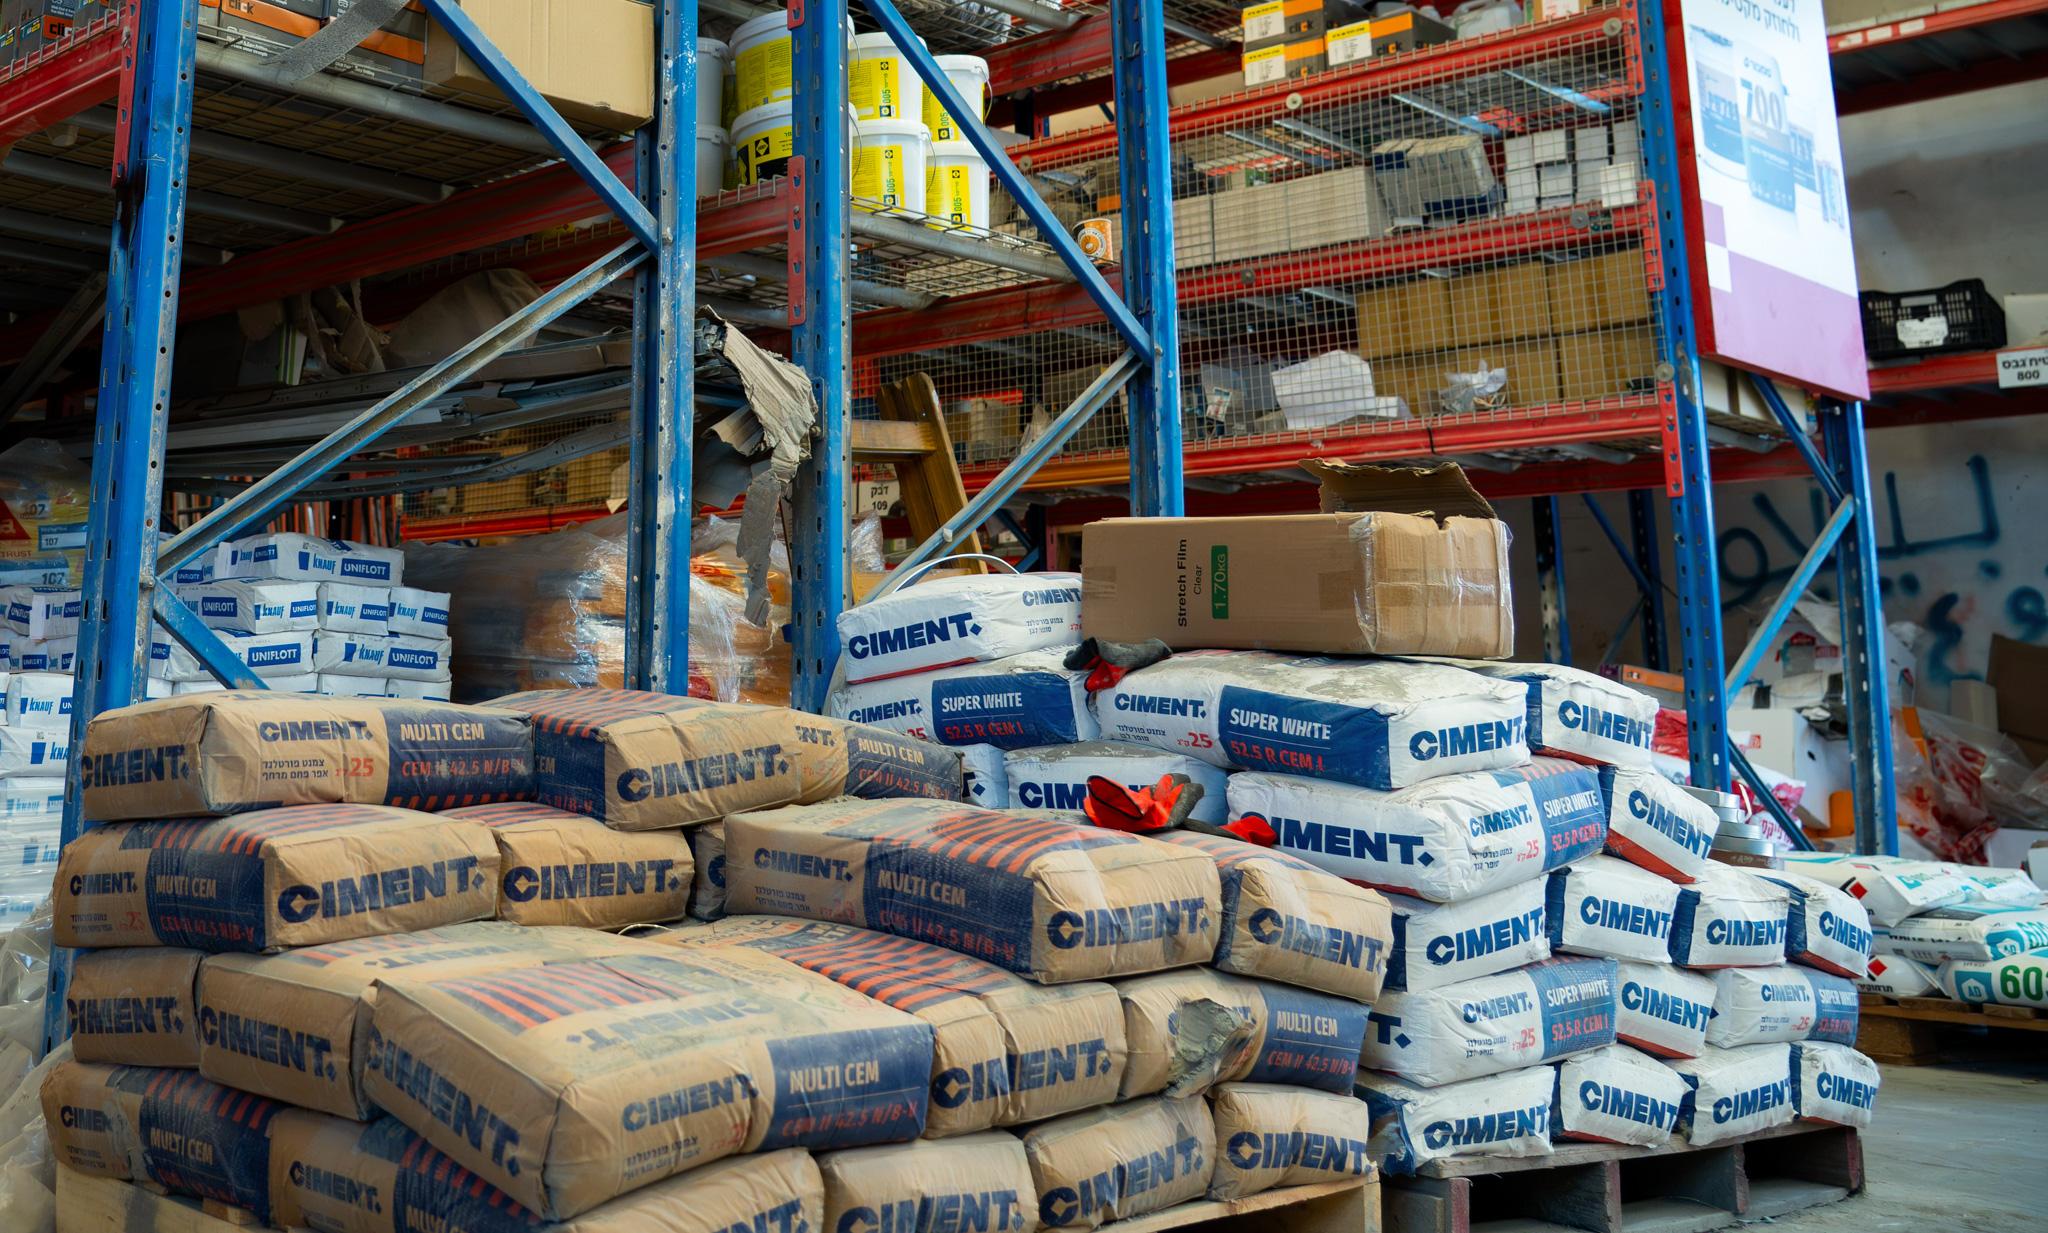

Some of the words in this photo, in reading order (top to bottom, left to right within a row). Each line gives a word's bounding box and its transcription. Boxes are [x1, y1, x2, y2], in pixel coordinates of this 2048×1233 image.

[2017, 370, 2040, 381] 800
[872, 501, 888, 510] 109
[1178, 538, 1188, 569] Film
[344, 563, 386, 576] UNIFLOTT
[1194, 564, 1202, 596] Clear
[292, 603, 316, 614] UNIFLOT
[1178, 572, 1188, 627] Stretch
[424, 611, 448, 622] UNIFLOT
[252, 649, 298, 662] UNIFLOTT
[392, 652, 434, 664] UNIFLOTT
[942, 694, 981, 713] SUPER
[984, 692, 1022, 710] WHITE
[400, 723, 448, 742] MULTI
[451, 723, 486, 741] CEM
[944, 725, 974, 740] 52.5
[975, 724, 984, 737] R
[988, 722, 1015, 736] CEM
[1229, 708, 1278, 732] SUPER
[1282, 717, 1332, 740] WHITE
[1188, 732, 1213, 749] 25
[858, 737, 897, 758] MULTI
[899, 746, 924, 766] CEM
[1230, 740, 1263, 760] 52.5
[1265, 746, 1276, 764] R
[1280, 749, 1312, 769] CEM
[303, 758, 324, 768] צמנט
[350, 758, 374, 776] 25
[401, 760, 430, 778] CEM
[450, 759, 480, 776] 42.5
[1544, 798, 1572, 820] SUPER
[1240, 812, 1424, 865] IMENT
[1526, 839, 1540, 860] 25
[192, 878, 216, 899] CEM
[878, 870, 928, 900] MULTI
[931, 878, 966, 908] CEM
[1967, 984, 1982, 997] AD
[2001, 964, 2048, 1001] 60
[1546, 985, 1578, 1008] SUPER
[1579, 979, 1610, 1000] WHITE
[1276, 1010, 1312, 1034] MULTI
[1314, 1016, 1338, 1038] CEM
[1552, 1022, 1573, 1042] 52.5
[1574, 1020, 1582, 1036] R
[1520, 1028, 1536, 1048] 25
[1268, 1050, 1291, 1067] CEM
[1305, 1051, 1330, 1072] 42.5
[788, 1064, 840, 1094] MULTI
[844, 1060, 880, 1087] CEM
[187, 1139, 214, 1164] CEM
